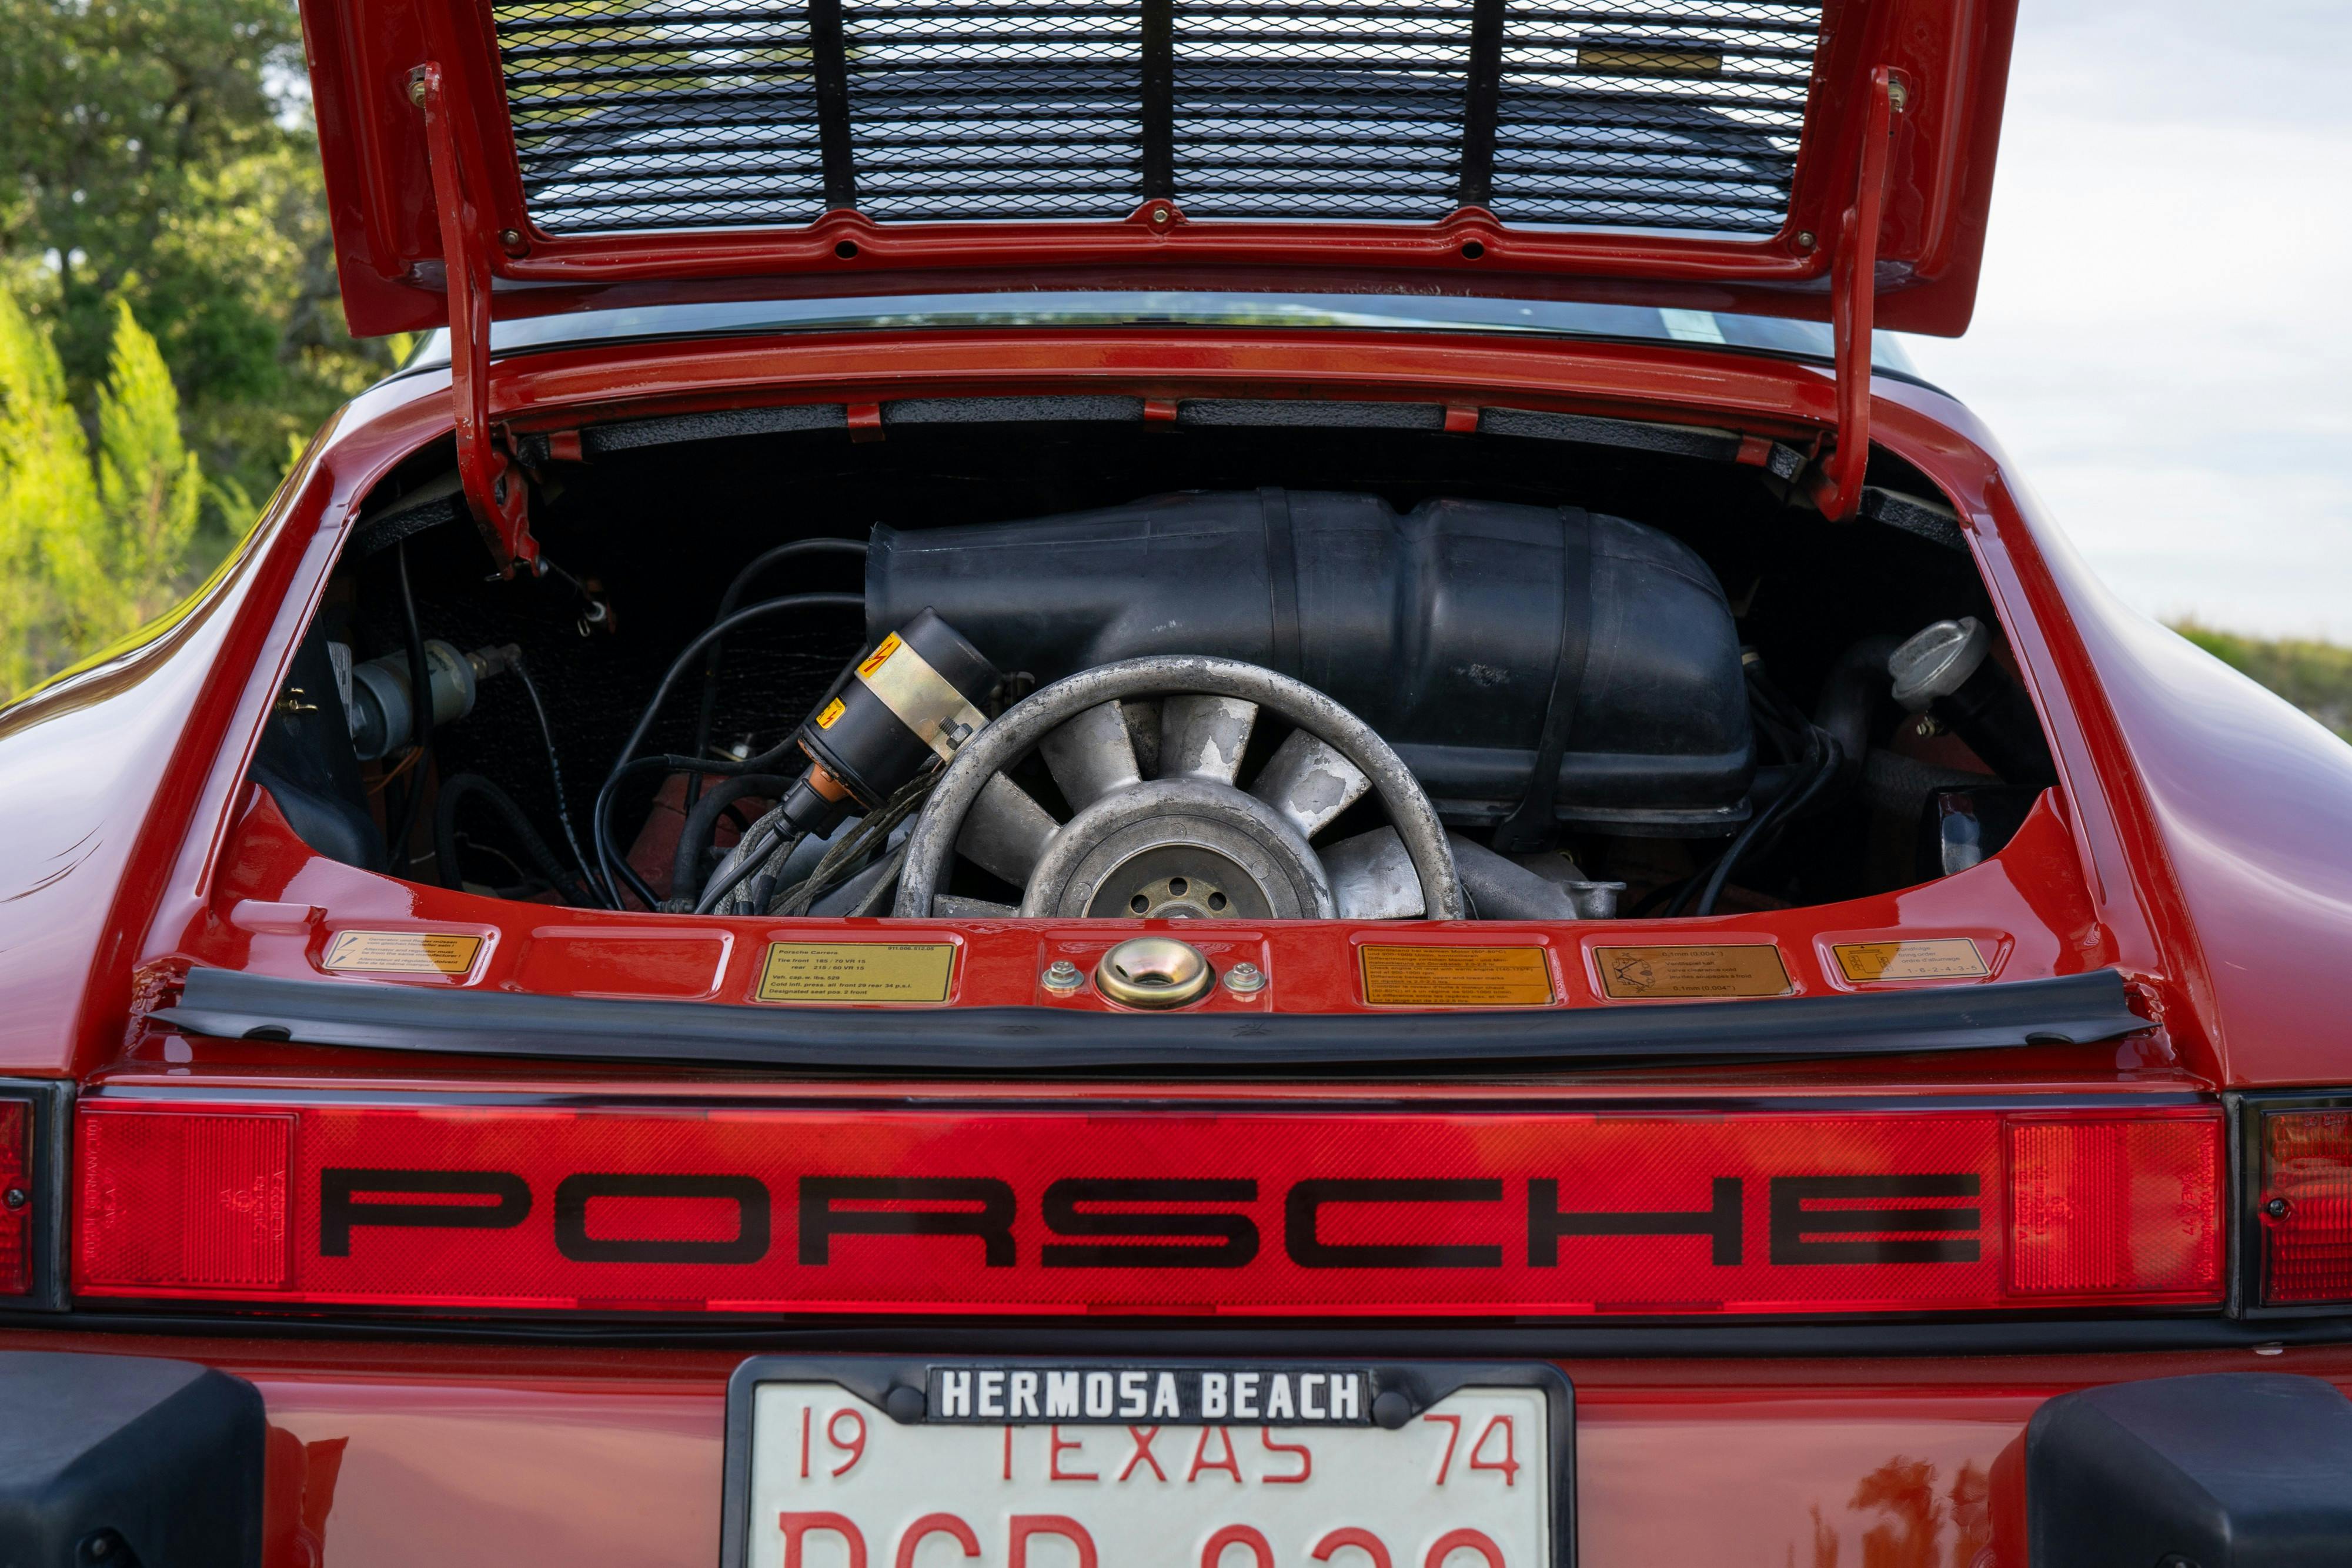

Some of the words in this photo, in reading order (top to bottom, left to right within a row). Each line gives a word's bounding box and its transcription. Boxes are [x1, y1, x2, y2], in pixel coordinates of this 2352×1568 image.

[319, 1168, 1980, 1269] PORSCHE
[942, 1370, 1180, 1418] HERMOSA
[1201, 1372, 1359, 1420] BEACH
[800, 1406, 867, 1479] 19
[1423, 1414, 1521, 1486] 74
